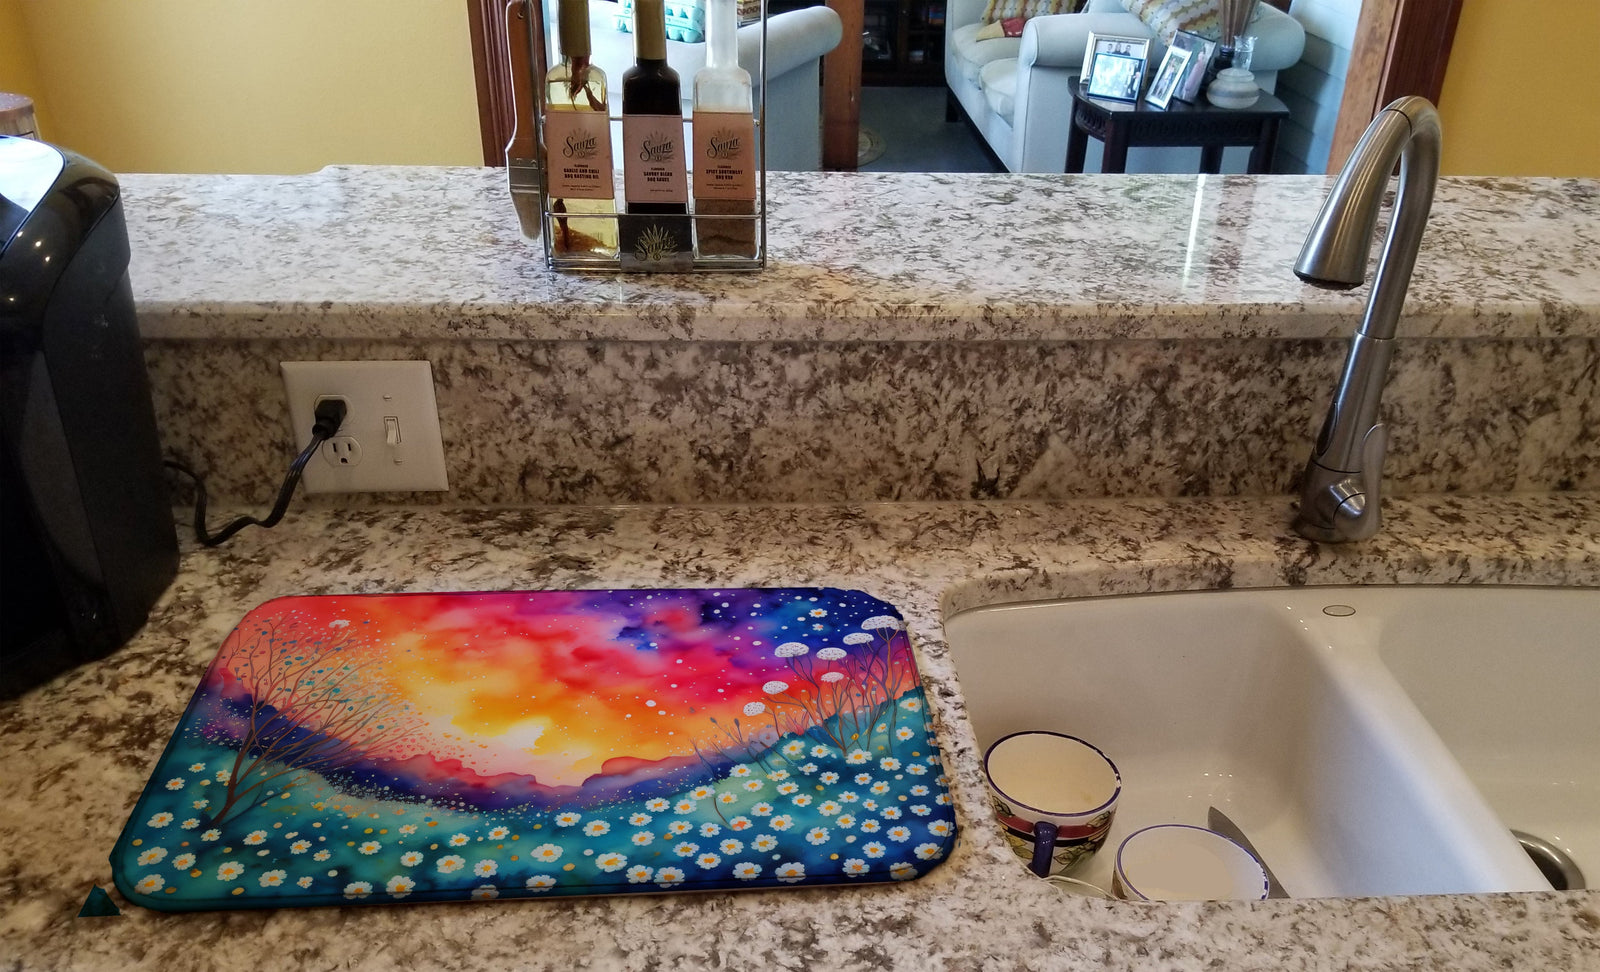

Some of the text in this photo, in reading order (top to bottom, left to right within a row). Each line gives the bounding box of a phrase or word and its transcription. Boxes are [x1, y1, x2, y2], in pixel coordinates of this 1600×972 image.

[563, 136, 599, 158] Sauza
[640, 140, 673, 161] Sauza
[707, 137, 739, 159] Sauza
